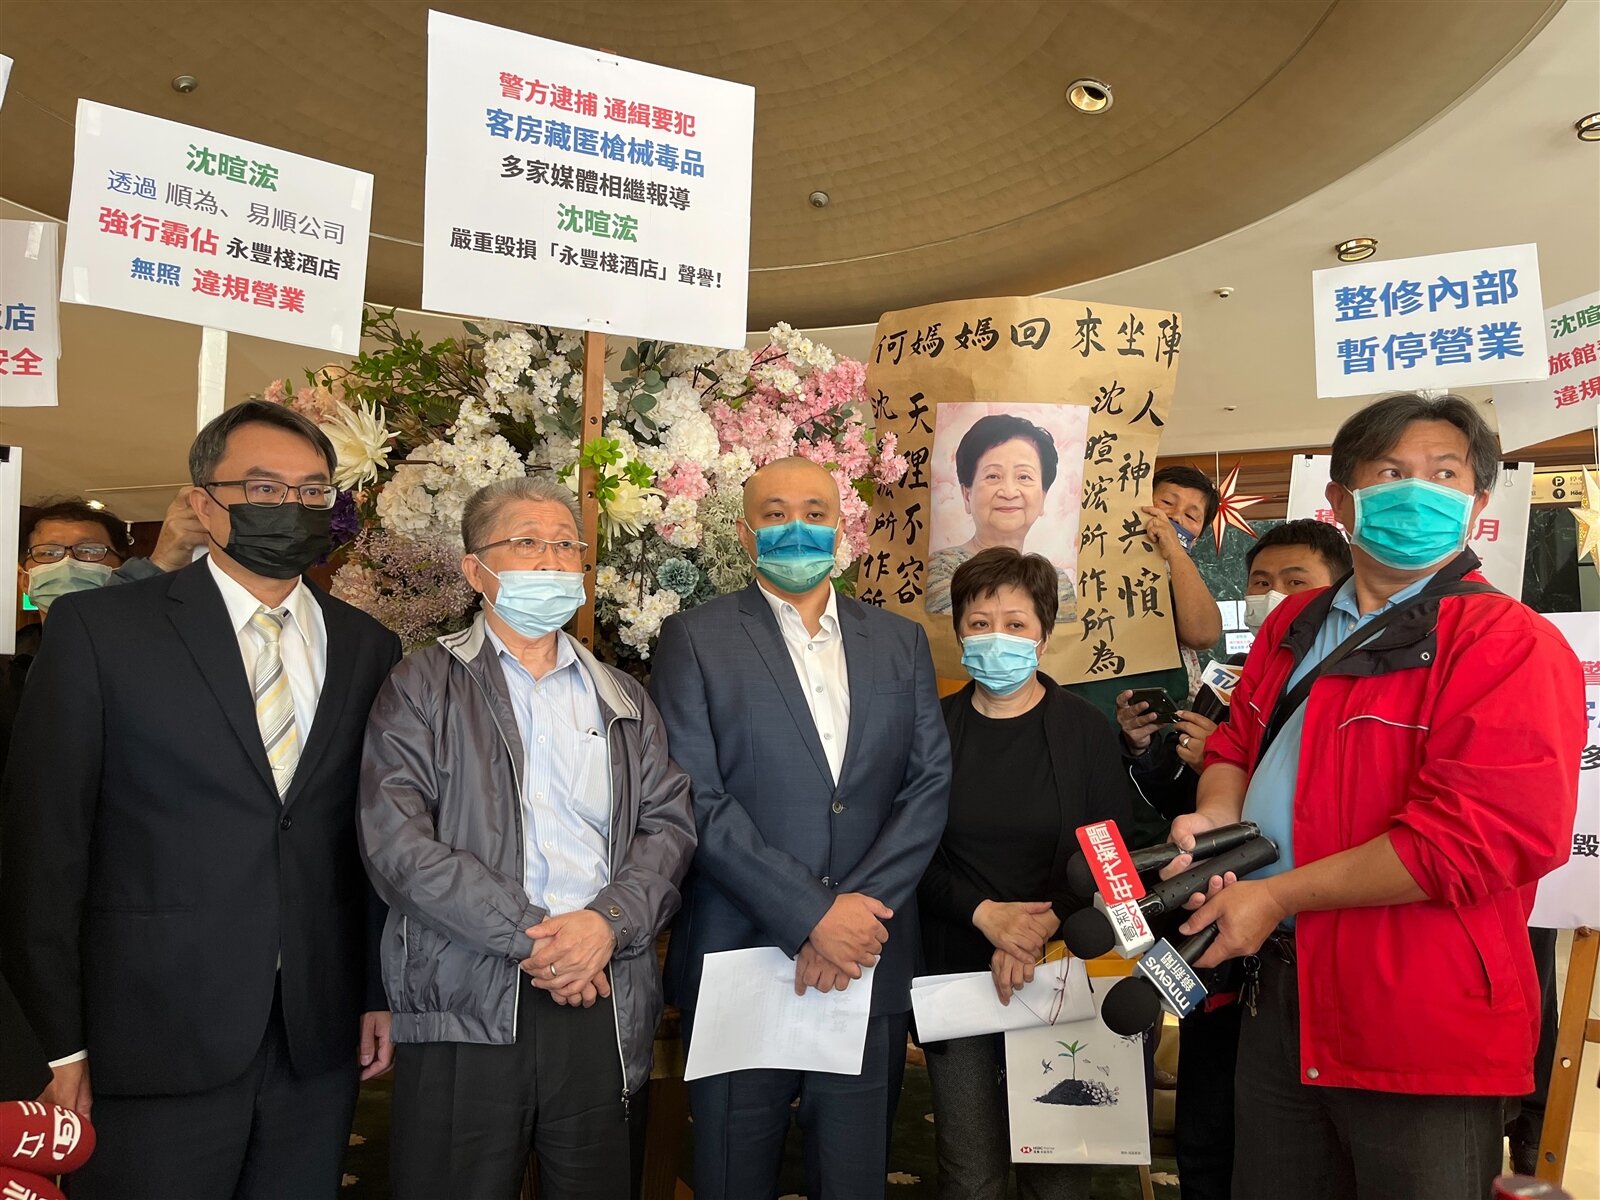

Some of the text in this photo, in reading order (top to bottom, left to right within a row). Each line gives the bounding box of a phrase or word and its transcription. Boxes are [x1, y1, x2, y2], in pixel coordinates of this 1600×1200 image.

[499, 72, 696, 137] 警方逮捕 通緝要犯
[186, 144, 278, 192] 沈暄浤
[485, 108, 704, 177] 客房藏匿槍械毒品
[107, 170, 156, 200] 透過
[500, 155, 690, 211] 多家媒體相繼報導
[99, 207, 340, 280] 強行霸佔 永豐棧酒店
[557, 203, 638, 243] 沈暄浤
[131, 257, 305, 313] 無照 違規營業
[1335, 268, 1519, 322] 整修內部
[0, 303, 36, 331] 店
[1337, 321, 1524, 375] 暫停營業
[1548, 340, 1600, 375] 旅館
[1117, 391, 1164, 618] 人神共憤
[1085, 823, 1133, 904] 年代新聞
[1109, 903, 1139, 942] 壹新
[1126, 904, 1147, 937] NEXT
[1145, 956, 1190, 1010] mnews
[1160, 951, 1197, 992] 鏡新聞
